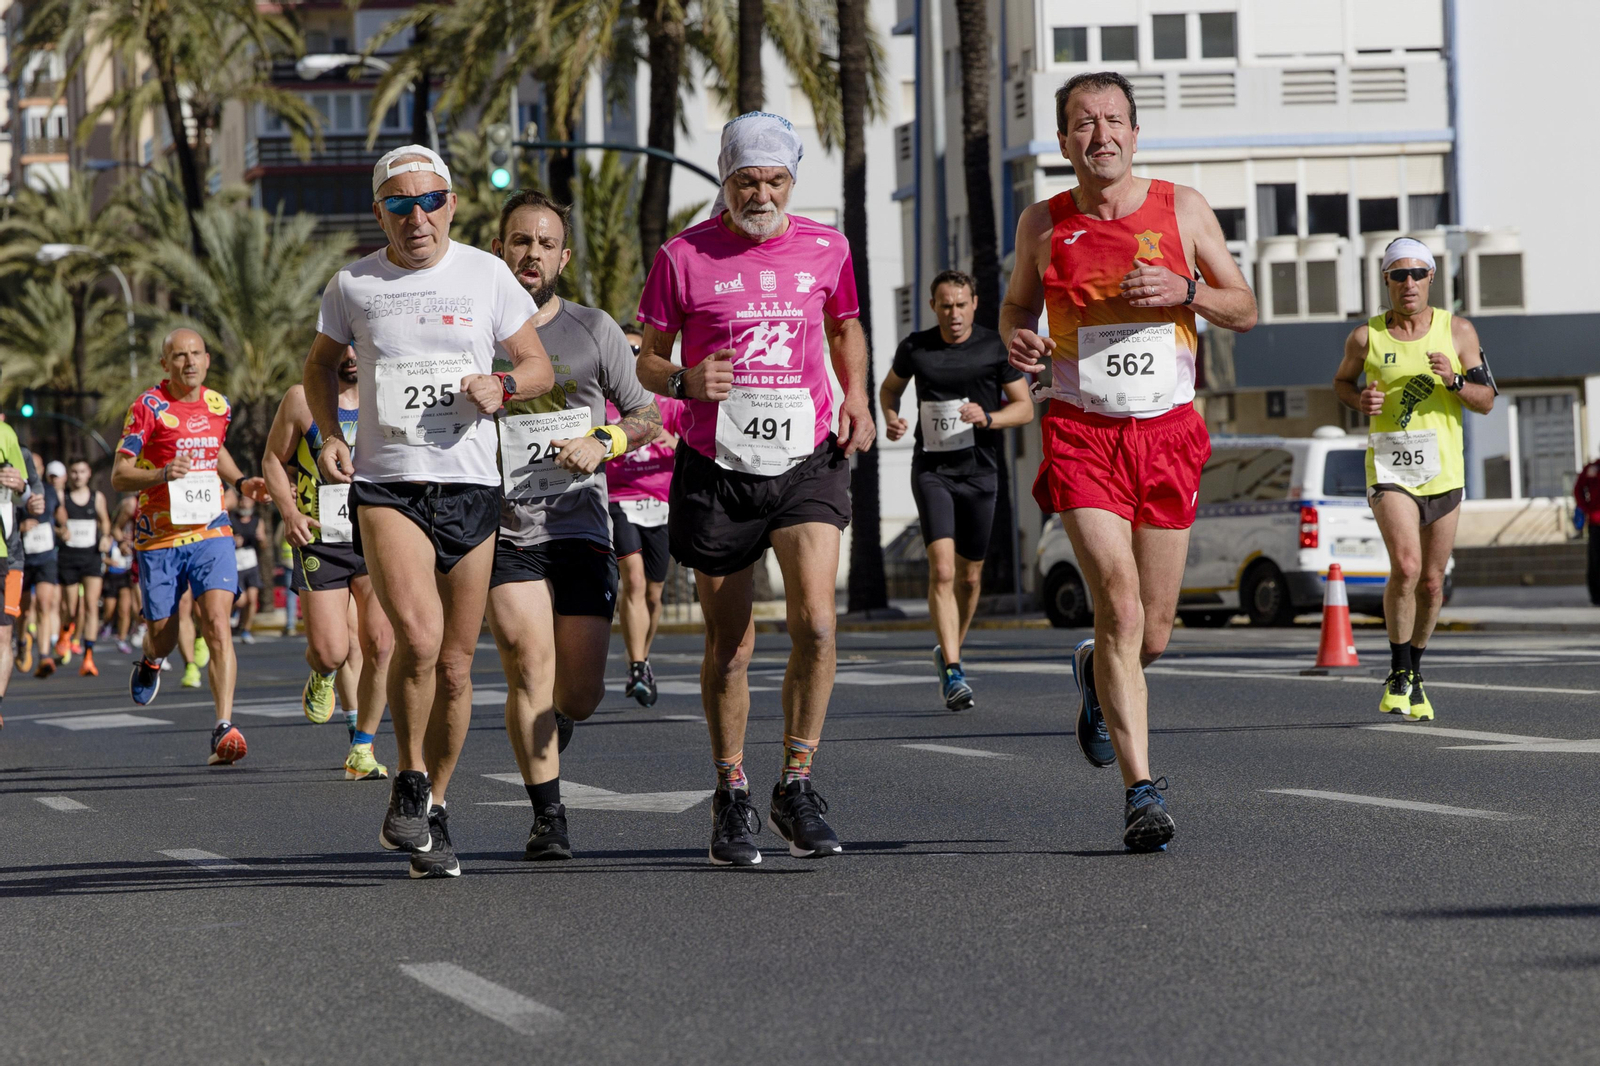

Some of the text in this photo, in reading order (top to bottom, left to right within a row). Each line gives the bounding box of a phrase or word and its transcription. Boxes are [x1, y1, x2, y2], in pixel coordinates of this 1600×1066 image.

[383, 290, 437, 300] TotalEnergies
[383, 297, 421, 309] Media
[426, 295, 474, 307] maratón
[366, 305, 472, 320] CIUDAD DE GRANADA
[736, 308, 803, 318] MEDIA MARATÓN
[1098, 330, 1116, 338] XXXV
[396, 362, 414, 370] XXXV
[414, 360, 437, 368] MEDIA
[430, 367, 439, 375] DE
[1106, 352, 1155, 377] 562
[761, 375, 774, 384] DE
[776, 374, 802, 384] CÁDIZ
[404, 383, 455, 410] 235
[741, 392, 759, 400] XXXV
[760, 393, 782, 401] MEDIA
[519, 419, 535, 427] XXXV
[535, 417, 557, 425] MEDIA
[932, 417, 957, 431] 767
[743, 417, 791, 441] 491
[176, 436, 219, 449] CORRER
[192, 448, 205, 459] DE
[527, 438, 570, 465] 24
[1392, 450, 1424, 466] 295
[185, 489, 211, 503] 646
